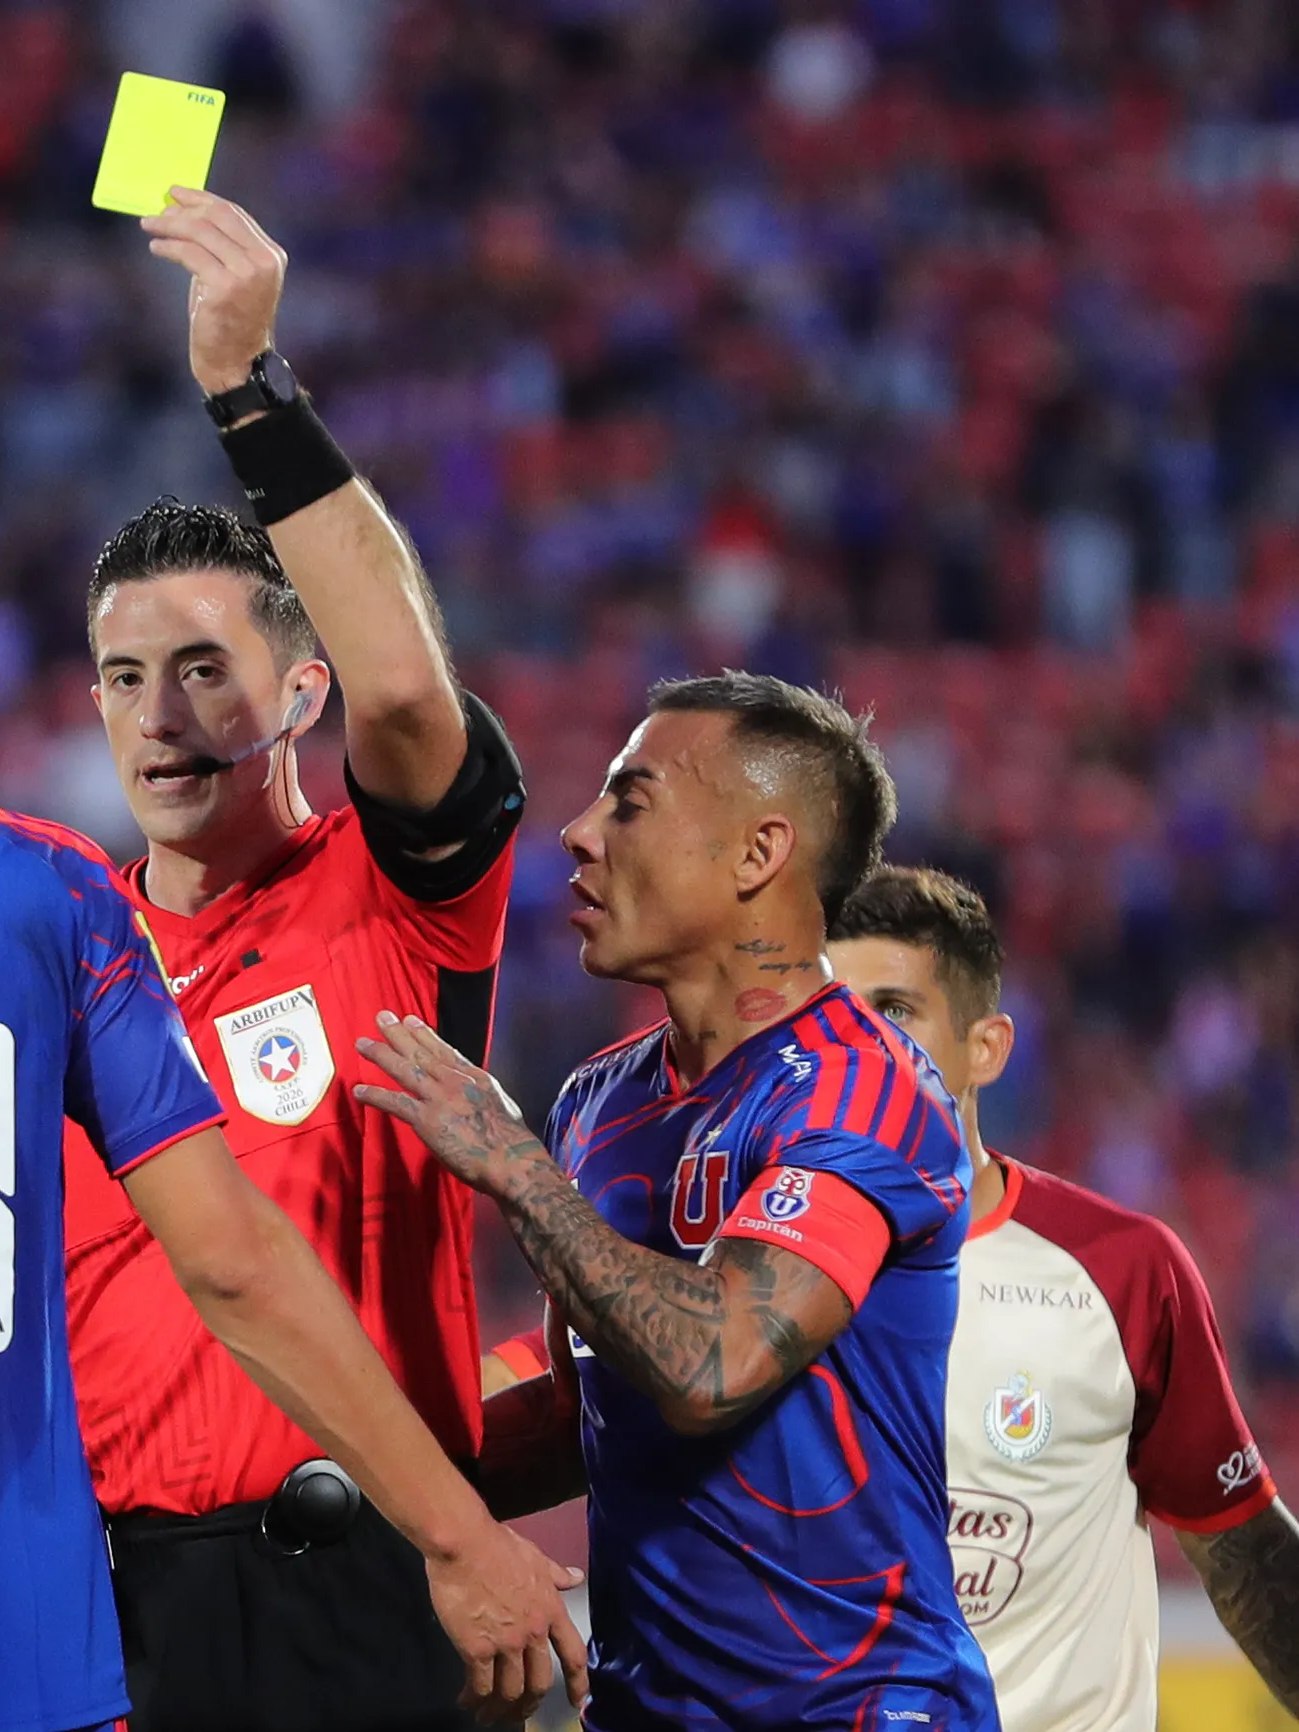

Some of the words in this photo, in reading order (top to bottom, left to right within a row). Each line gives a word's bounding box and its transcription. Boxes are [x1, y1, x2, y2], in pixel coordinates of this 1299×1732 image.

[187, 91, 216, 106] FIFA
[230, 995, 300, 1033] ARBIFUP
[274, 1099, 309, 1117] CHILE
[277, 1088, 304, 1106] 2026
[669, 1151, 729, 1249] U
[769, 1193, 797, 1216] U
[737, 1216, 804, 1243] Capitán
[979, 1281, 1093, 1310] NEWKAR
[947, 1498, 1013, 1539] tas
[954, 1556, 995, 1598] al
[959, 1601, 989, 1616] OM
